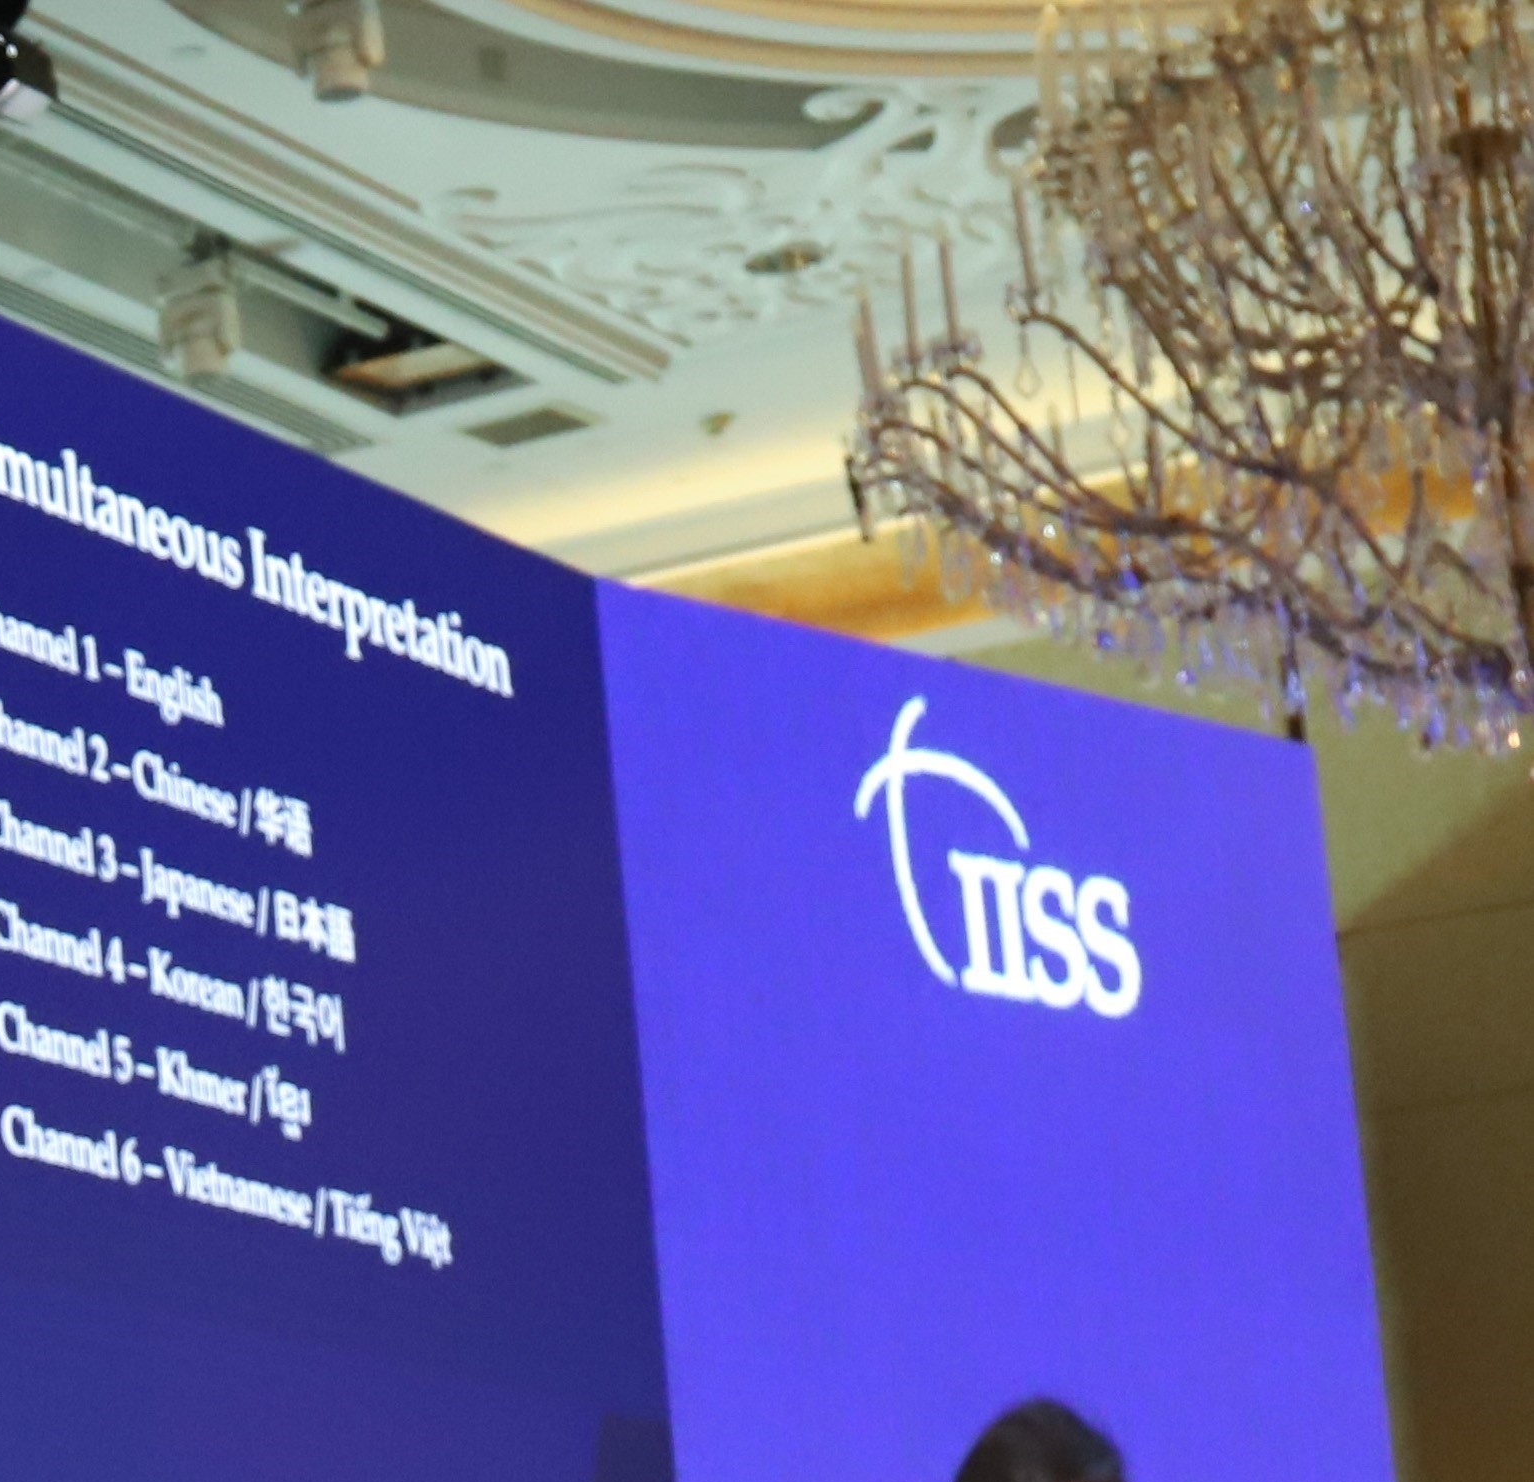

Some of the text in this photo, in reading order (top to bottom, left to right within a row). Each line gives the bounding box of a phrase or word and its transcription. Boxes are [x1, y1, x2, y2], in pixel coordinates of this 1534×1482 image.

[247, 526, 514, 698] Interpretation
[82, 634, 101, 682] 1
[123, 649, 225, 728] English
[89, 734, 111, 784] 2
[132, 750, 238, 828] Chinese
[253, 787, 313, 858] 华语
[96, 833, 118, 883] 3
[140, 847, 256, 928] Japanese
[273, 889, 357, 964] 日本語
[947, 848, 1143, 1019] IISS
[104, 935, 126, 984] 4
[147, 946, 246, 1020] Korean
[261, 974, 346, 1053] 한국어
[113, 1034, 134, 1085] 5
[155, 1046, 248, 1116] Khmer
[0, 1105, 120, 1180] Channel
[120, 1137, 143, 1186] 6
[162, 1145, 313, 1230] Vietnamese
[328, 1189, 402, 1266] Tiếng
